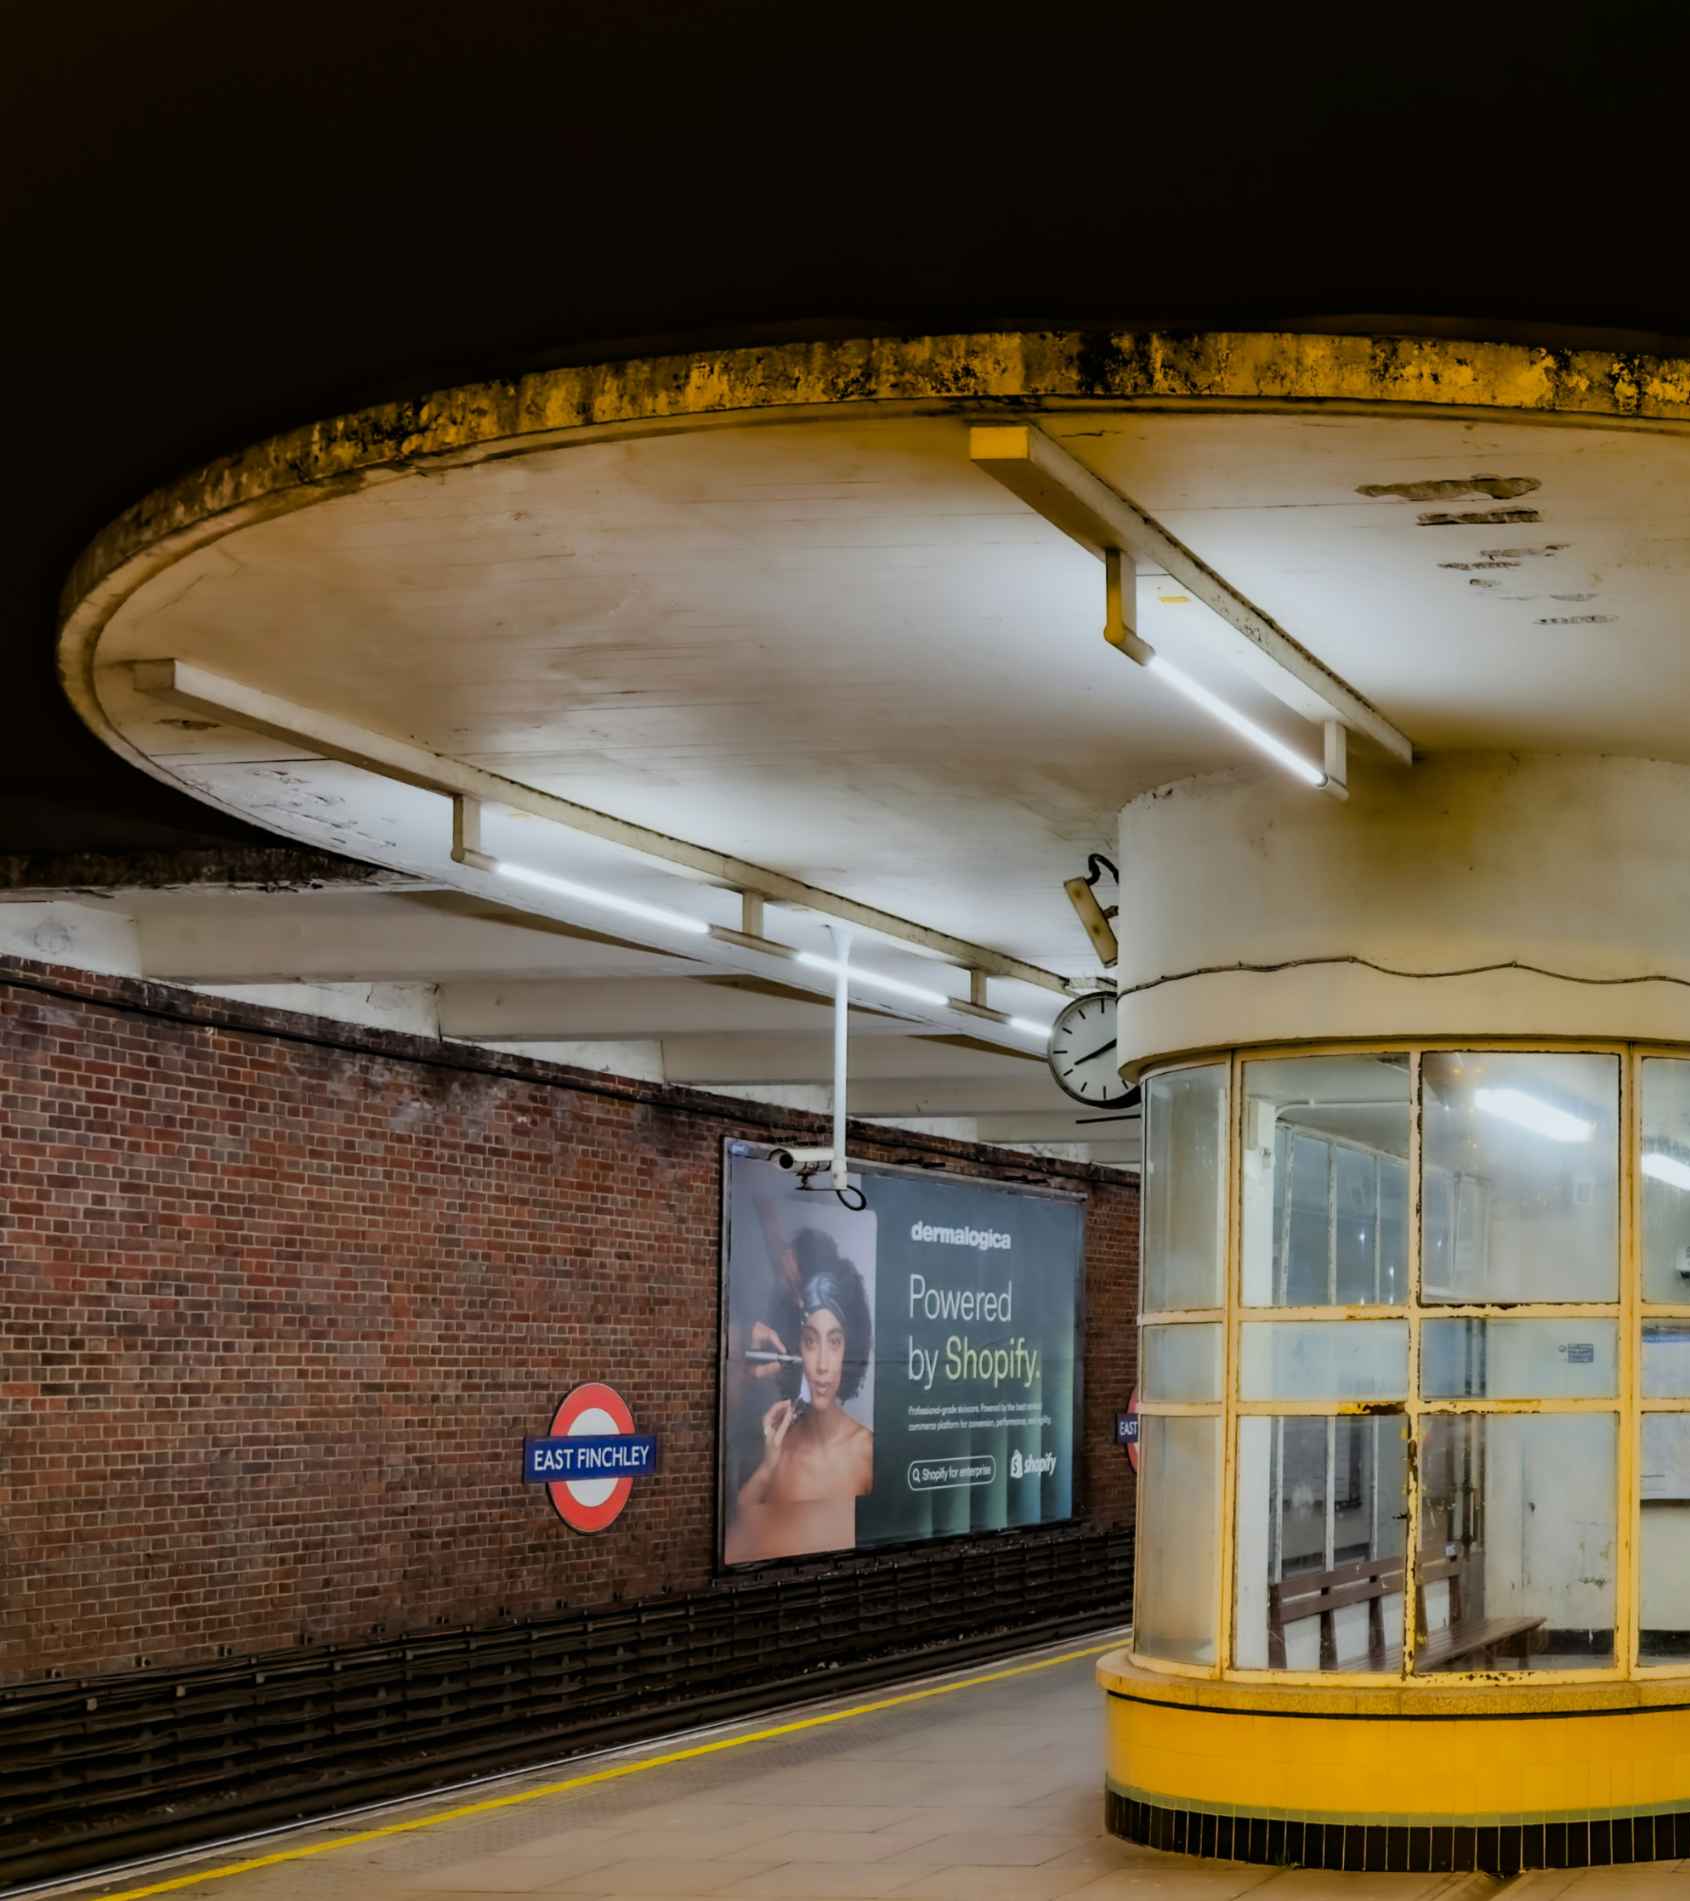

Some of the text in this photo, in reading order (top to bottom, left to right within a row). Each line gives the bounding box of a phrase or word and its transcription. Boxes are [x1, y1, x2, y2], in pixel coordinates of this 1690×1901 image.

[911, 1220, 1011, 1250] dermalogica
[909, 1273, 1012, 1322] Powered
[908, 1335, 1040, 1390] by Shopify.
[534, 1445, 650, 1471] EAST FINCHLEY
[1024, 1451, 1057, 1477] shopify
[921, 1466, 949, 1482] Shopify
[949, 1465, 958, 1478] for
